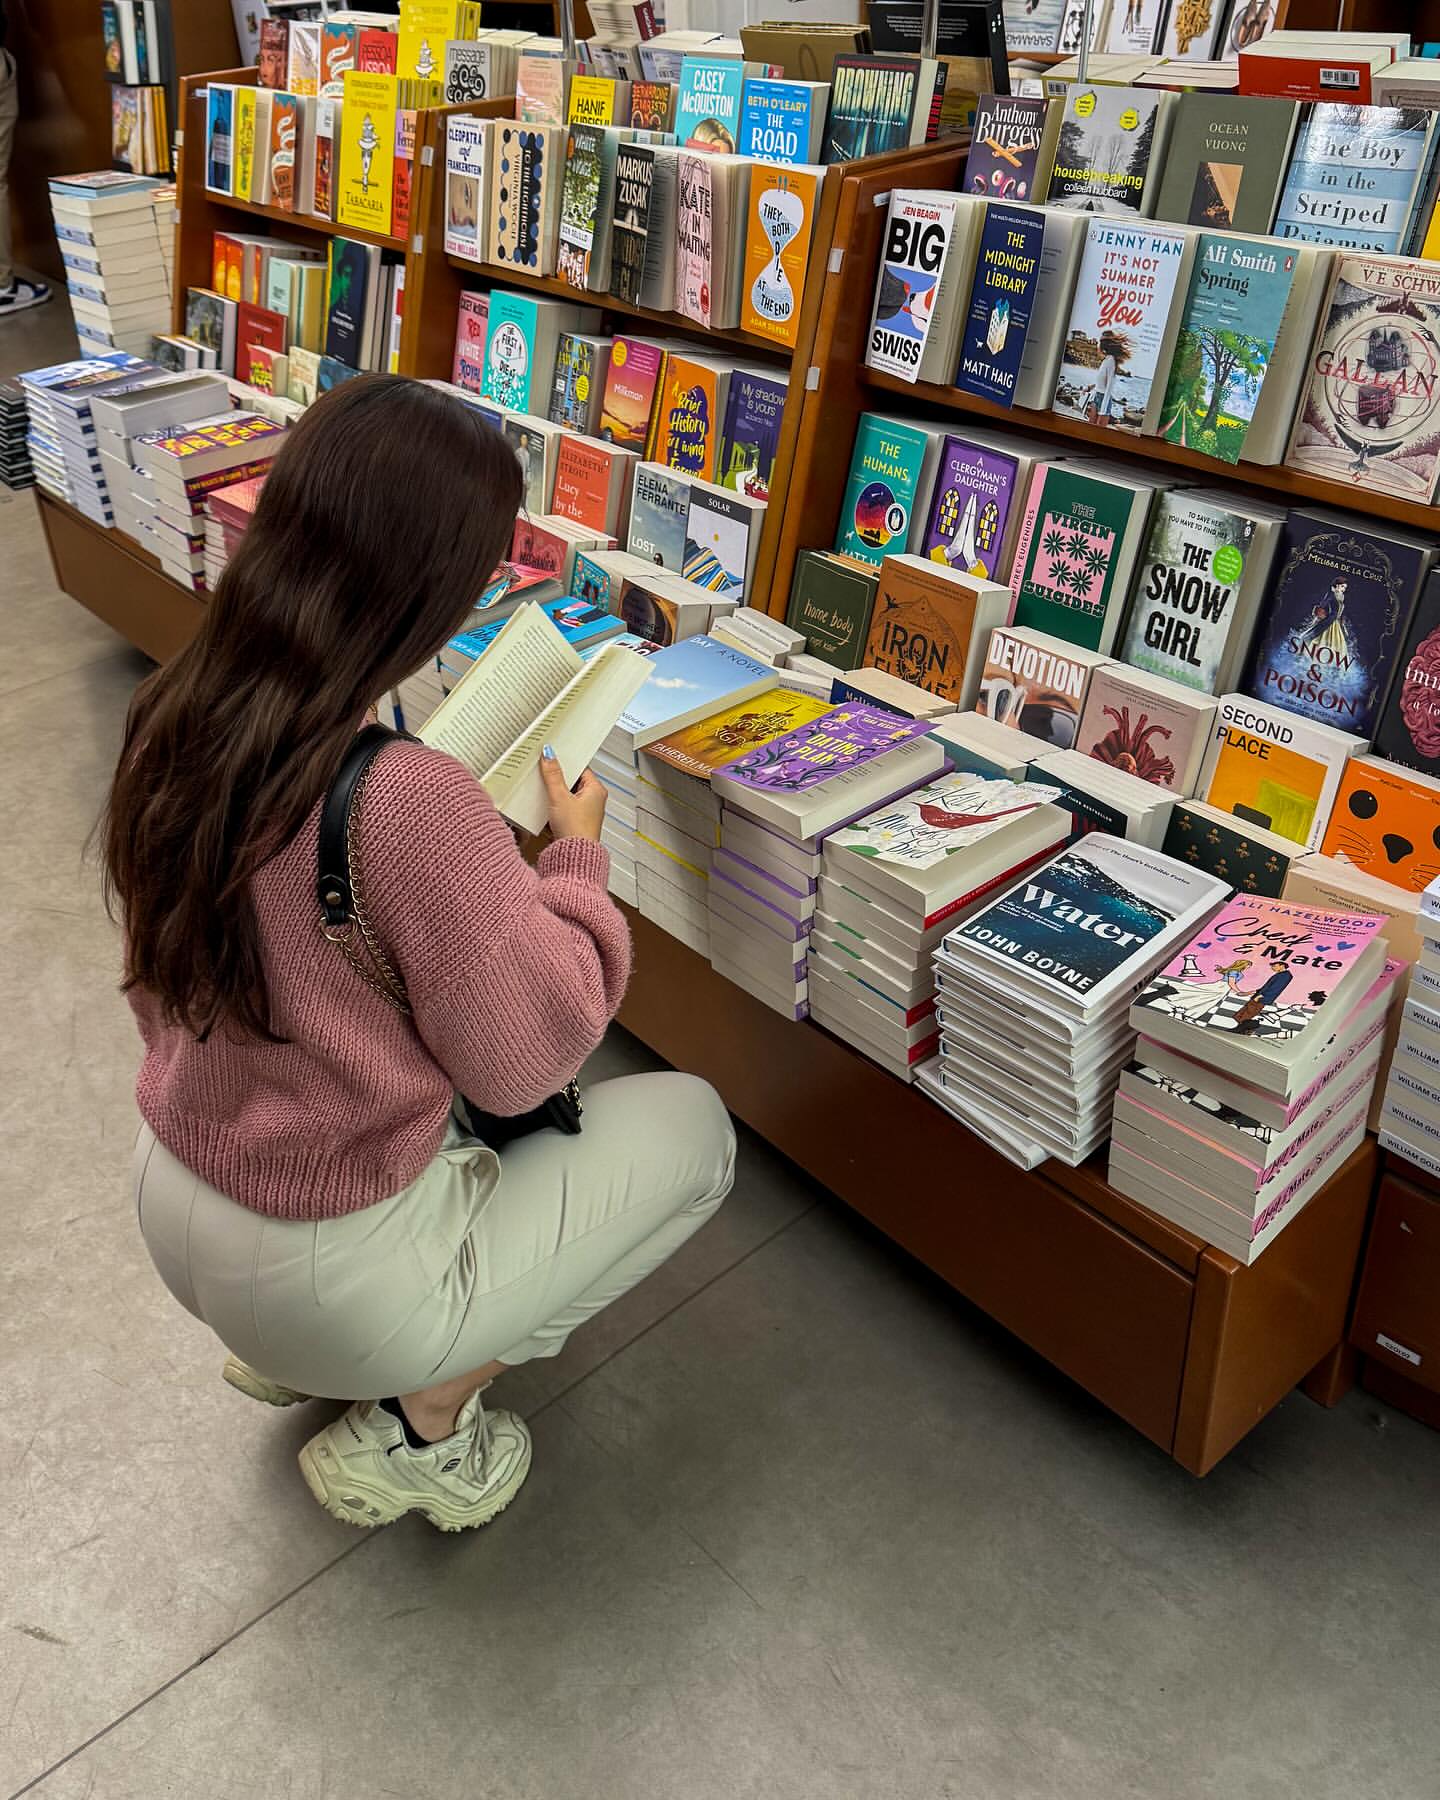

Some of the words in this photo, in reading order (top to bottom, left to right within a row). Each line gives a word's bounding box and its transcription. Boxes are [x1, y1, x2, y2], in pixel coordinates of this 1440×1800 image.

[693, 69, 726, 92] CASEY
[833, 66, 914, 115] DROWNING
[576, 98, 606, 116] HANIF
[747, 96, 769, 107] BETH
[770, 98, 808, 113] O'LEARY
[990, 103, 1039, 127] Anthony
[767, 113, 784, 129] THE
[976, 111, 1043, 151] Burgess
[1209, 122, 1249, 135] OCEAN
[448, 128, 482, 146] CLEOPATRA
[751, 127, 798, 156] ROAD
[1205, 139, 1248, 152] VUONG
[1360, 139, 1406, 166] Boy
[447, 159, 481, 176] FRANKENSTEIN
[617, 155, 653, 186] MARKUS
[1054, 163, 1144, 190] housebreaking
[1063, 183, 1093, 195] colleen
[1093, 185, 1128, 199] hubbard
[1319, 170, 1338, 186] in
[1347, 171, 1376, 191] the
[345, 192, 385, 213] TABACARIA
[619, 182, 647, 209] ZUSAK
[763, 203, 783, 222] THEY
[902, 206, 917, 218] JEN
[916, 208, 941, 221] BEAGIN
[1295, 192, 1388, 226] Striped
[692, 213, 701, 235] IN
[772, 223, 790, 236] BOTH
[678, 230, 711, 262] WAITING
[885, 217, 946, 274] BIG
[1007, 231, 1026, 249] THE
[1098, 230, 1146, 250] JENNY
[1151, 239, 1183, 257] HAN
[984, 249, 1036, 275] MIDNIGHT
[1104, 251, 1127, 266] IT'S
[1132, 256, 1160, 273] NOT
[1203, 244, 1228, 264] Ali
[1230, 248, 1277, 274] Smith
[757, 279, 766, 291] AT
[1100, 268, 1155, 289] SUMMER
[1200, 268, 1250, 298] Spring
[760, 294, 774, 312] THE
[774, 299, 790, 316] END
[1096, 284, 1154, 306] WITHOUT
[1097, 293, 1144, 328] You
[501, 331, 518, 350] FIRST
[871, 329, 921, 366] SWISS
[459, 359, 481, 382] ROYAL
[499, 360, 510, 374] DIE
[962, 357, 990, 379] MATT
[990, 367, 1014, 390] HAIG
[613, 383, 644, 402] Milkman
[671, 380, 679, 398] A
[741, 382, 754, 399] My
[755, 388, 786, 407] shadow
[678, 390, 702, 413] Brief
[746, 396, 753, 409] is
[753, 402, 777, 418] yours
[670, 412, 706, 441] History
[879, 440, 903, 459] THE
[863, 455, 909, 481] HUMANS
[950, 459, 1008, 487] CLERGYMAN'S
[976, 456, 984, 467] A
[557, 475, 580, 498] Lucy
[638, 474, 669, 496] ELENA
[954, 472, 998, 496] DAUGHTER
[554, 496, 569, 516] by
[568, 501, 584, 519] the
[636, 488, 687, 516] FERRANTE
[707, 497, 731, 513] SOLAR
[1071, 502, 1097, 519] THE
[1050, 510, 1115, 541] VIRGIN
[1168, 515, 1179, 524] YOU
[1180, 519, 1194, 528] HAVE
[1195, 522, 1203, 530] TO
[1203, 525, 1216, 535] FIND
[1196, 514, 1210, 523] SAVE
[631, 535, 655, 554] LOST
[1018, 508, 1036, 561] EUGENIDES
[1183, 542, 1213, 572] THE
[1023, 580, 1106, 618] SUICIDES
[1146, 563, 1231, 624] SNOW
[803, 598, 829, 625] home
[831, 611, 855, 640] body
[690, 636, 716, 649] DAY
[881, 621, 949, 675] IRON
[1144, 611, 1202, 667] GIRL
[718, 649, 727, 658] A
[727, 652, 766, 677] NOVEL
[988, 632, 1086, 698] DEVOTION
[1288, 636, 1354, 672] SNOW
[1306, 664, 1323, 684] &
[1263, 668, 1358, 717] POISON
[1221, 704, 1293, 744] SECOND
[805, 733, 864, 756] DATING
[1215, 726, 1272, 760] PLACE
[789, 746, 838, 765] PLAN
[1021, 883, 1145, 949] Water
[1236, 899, 1262, 911] ALI
[1268, 905, 1378, 929] HAZELWOOD
[1213, 916, 1315, 947] Check
[965, 925, 1022, 955] JOHN
[1022, 950, 1095, 991] BOYNE
[1260, 944, 1345, 971] Mate
[1406, 1044, 1440, 1065] WILLIAM
[1397, 1074, 1430, 1096] WILLIAM
[1391, 1106, 1424, 1130] WILLIAM
[1387, 1138, 1419, 1161] WILLIAM
